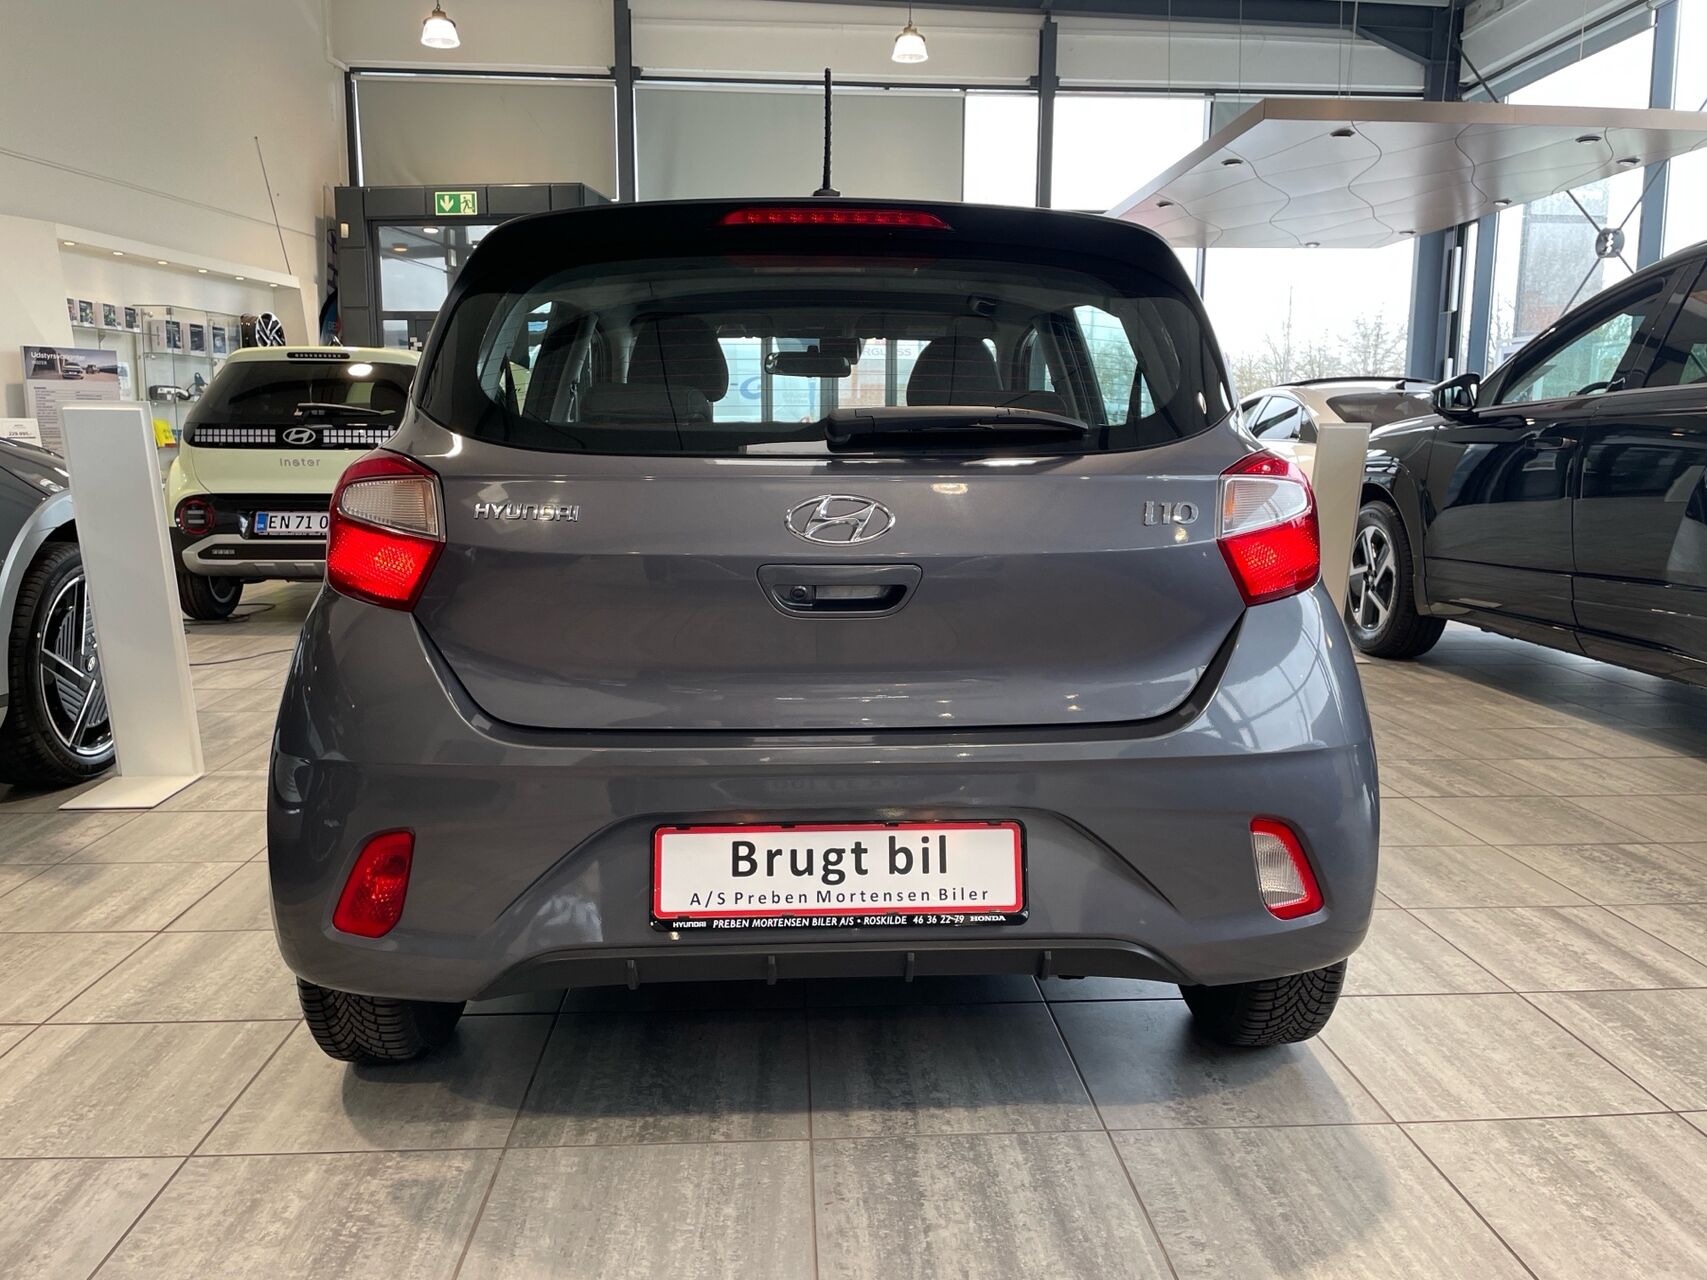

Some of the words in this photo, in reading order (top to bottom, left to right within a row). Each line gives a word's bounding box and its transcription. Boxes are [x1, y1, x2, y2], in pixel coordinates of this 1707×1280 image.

[279, 457, 321, 467] Inster
[473, 502, 580, 522] HYUNDAI
[268, 515, 291, 529] EN
[295, 515, 313, 529] 71
[731, 840, 869, 886] Brugt
[888, 834, 947, 875] bil
[689, 890, 726, 908] A/S
[734, 889, 809, 905] Preben
[816, 888, 931, 904] Mortensen
[939, 887, 990, 902] Biler
[712, 919, 749, 929] PREBEN
[751, 917, 810, 928] MORTENSEN
[811, 917, 837, 927] BILER
[838, 916, 854, 927] A/S
[863, 916, 908, 926] ROSKILDE
[913, 915, 924, 925] 46
[926, 915, 938, 924] 36
[969, 914, 1007, 922] HONDA
